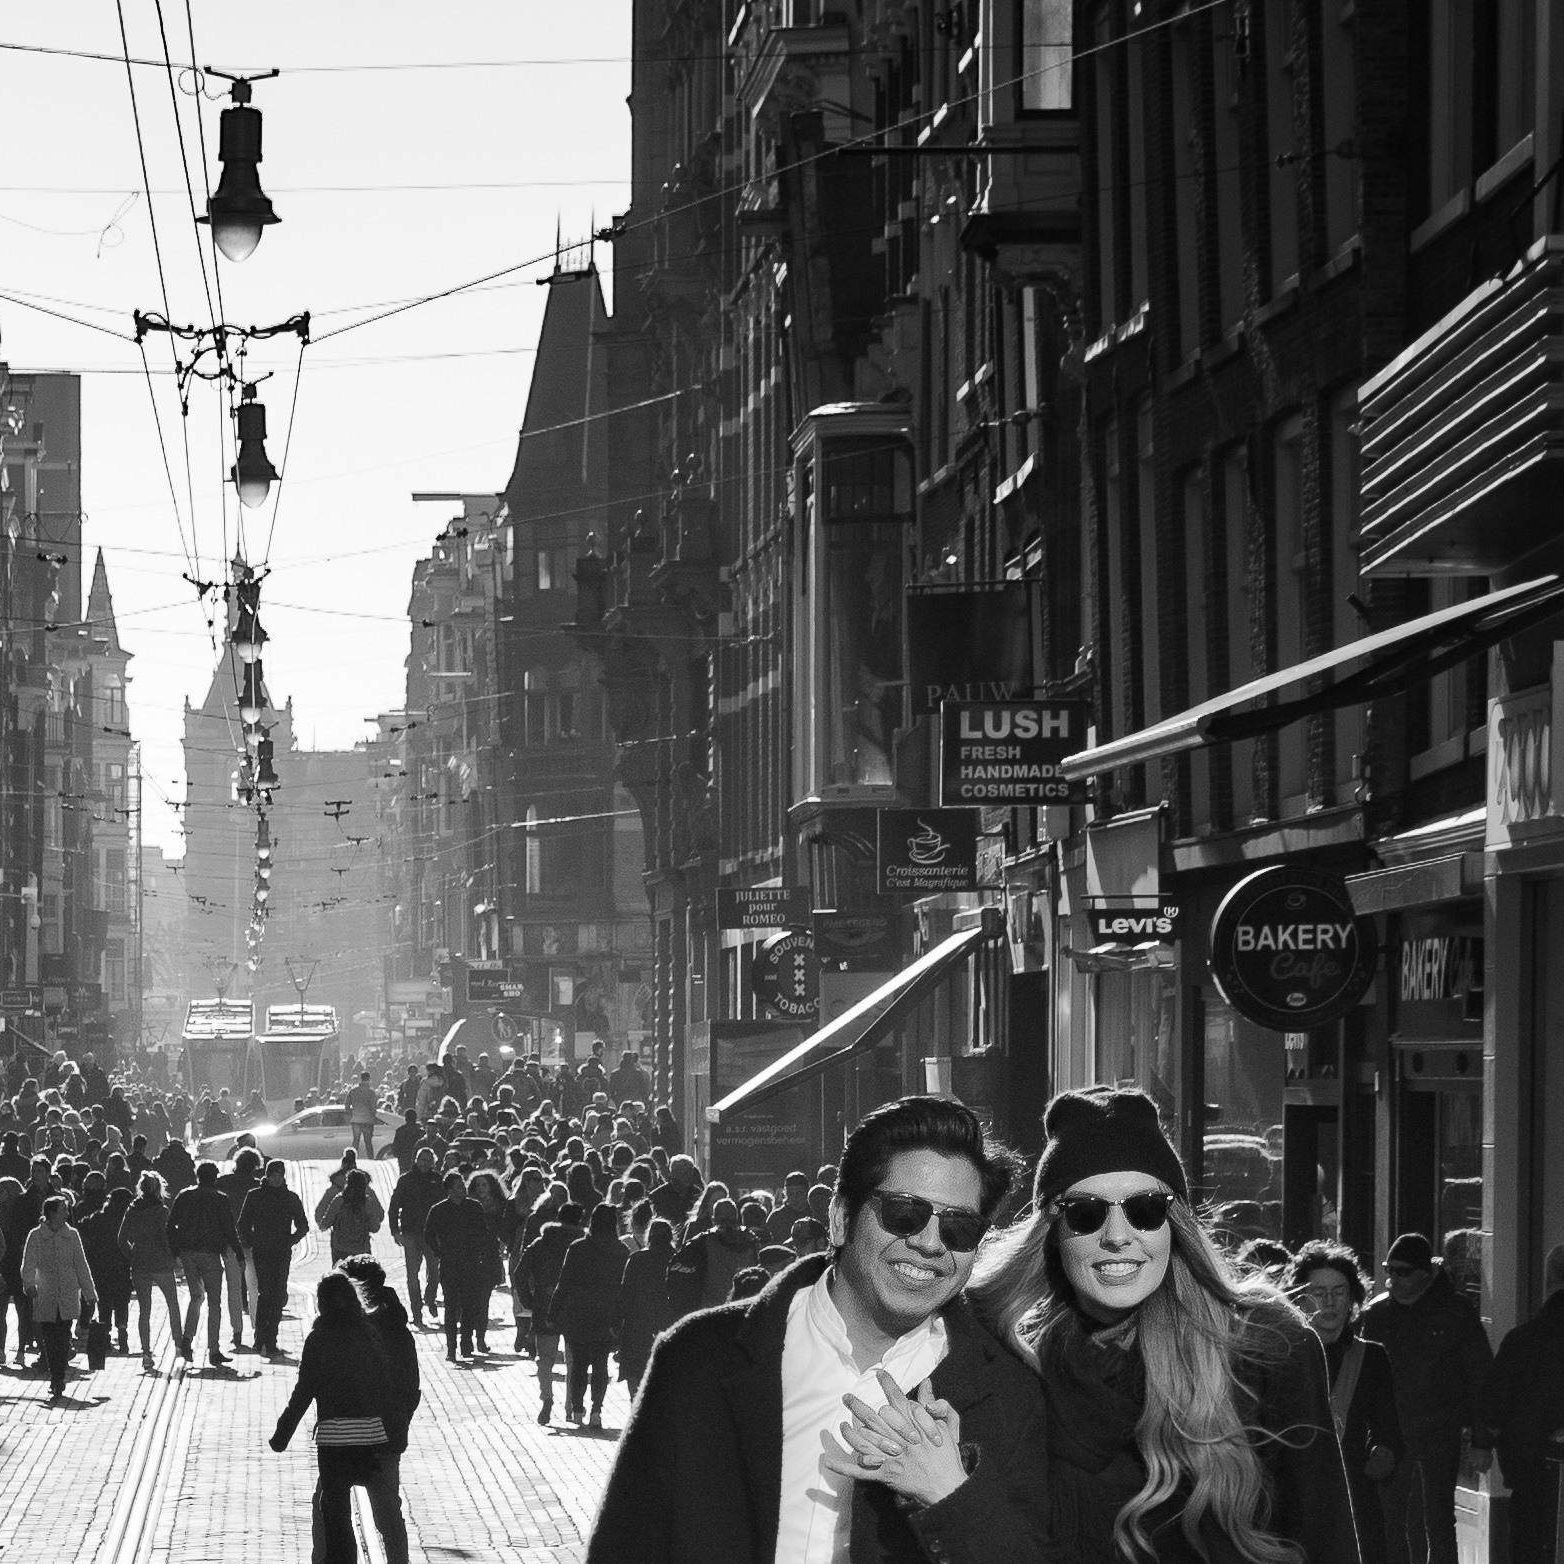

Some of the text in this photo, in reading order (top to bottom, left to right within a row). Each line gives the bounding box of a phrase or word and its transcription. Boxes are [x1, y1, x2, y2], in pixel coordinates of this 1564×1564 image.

[960, 709, 1070, 739] LUSH
[960, 746, 1021, 759] FRESH
[960, 783, 1069, 798] COSMETICS
[886, 864, 969, 876] Croissanterie
[736, 889, 790, 904] JULIETTE
[748, 903, 777, 912] pour
[743, 914, 785, 925] ROMEO
[1237, 923, 1354, 951] BAKERY
[1402, 937, 1449, 1001] BAKERY
